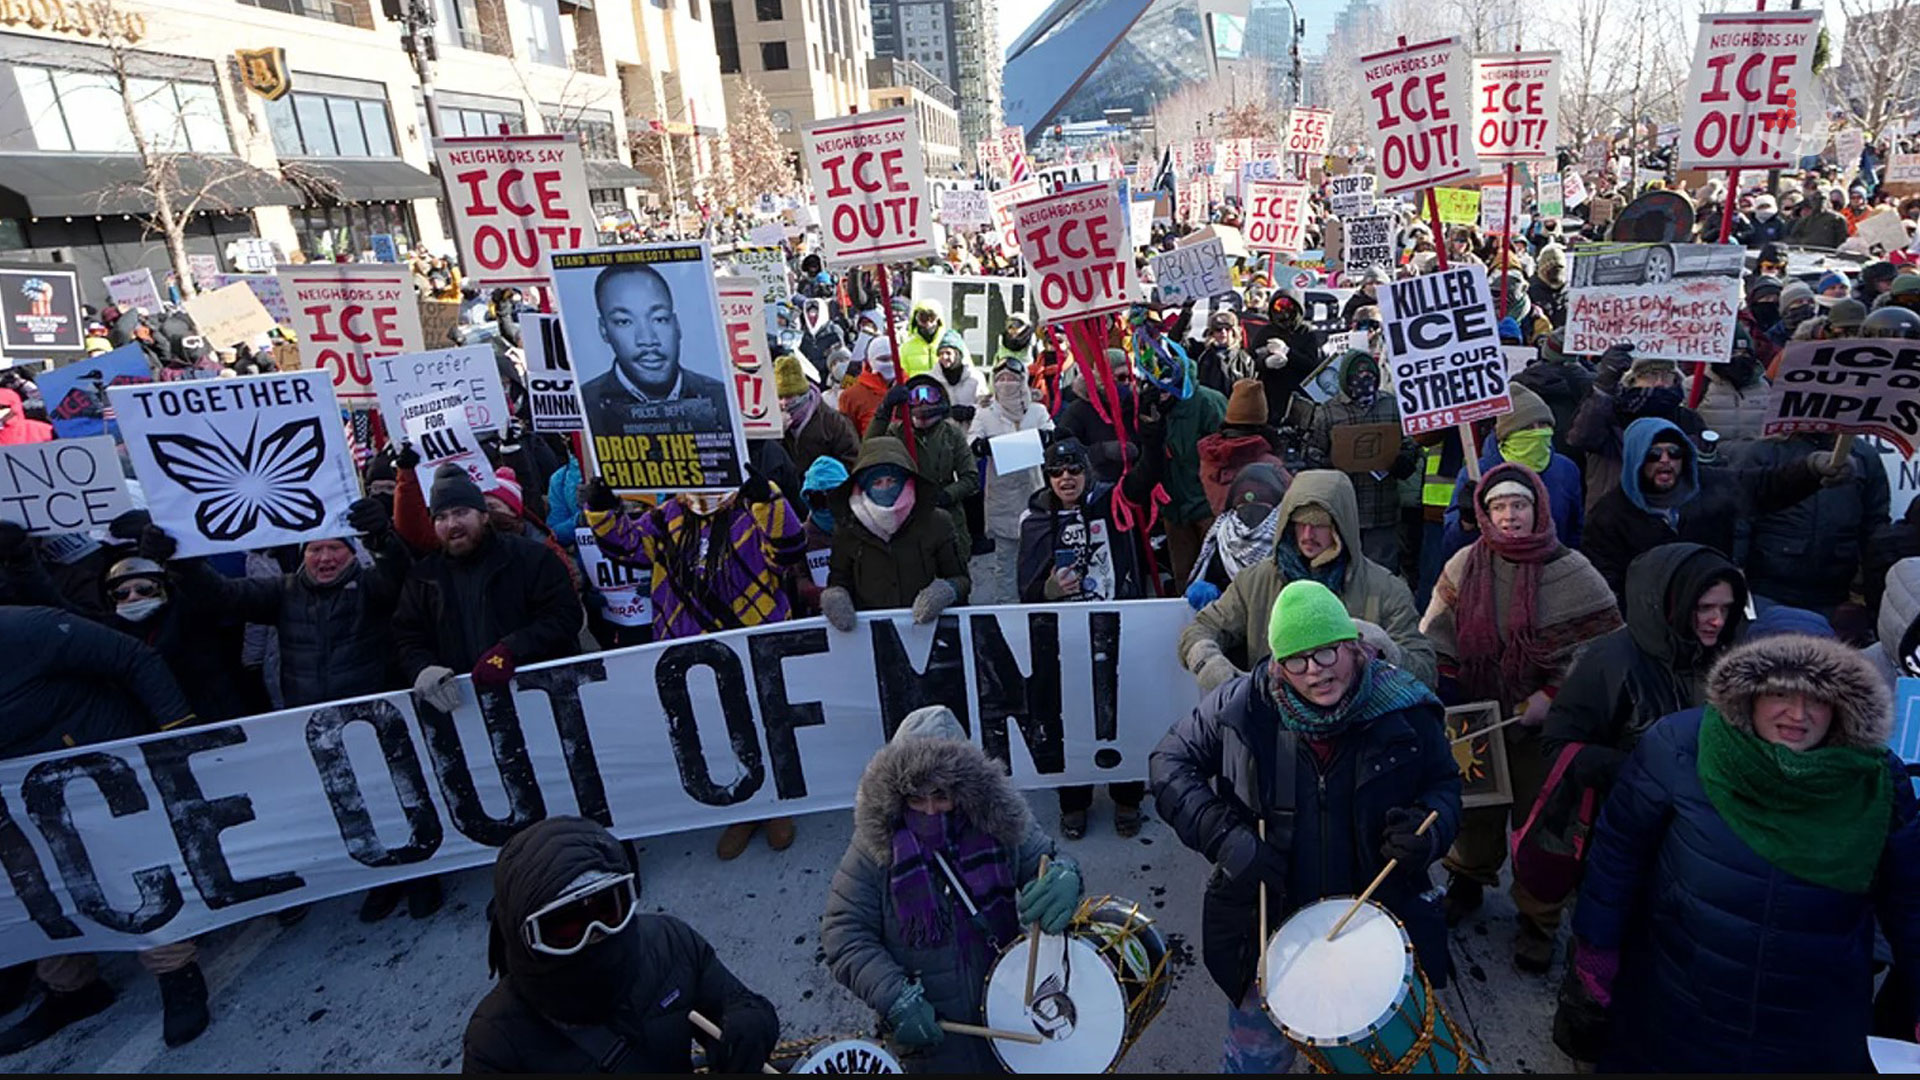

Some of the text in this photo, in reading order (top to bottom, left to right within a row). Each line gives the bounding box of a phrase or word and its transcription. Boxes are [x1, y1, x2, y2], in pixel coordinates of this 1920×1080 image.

[1710, 32, 1807, 49] NEIGHBORS SAY
[1365, 52, 1450, 82] NEIGHBORS SAY
[1701, 52, 1797, 105] ICE
[1371, 72, 1450, 130] ICE
[1482, 81, 1544, 115] ICE
[1292, 118, 1325, 136] ICE
[1479, 119, 1548, 150] OUT!
[1694, 110, 1791, 160] OUT!
[450, 149, 564, 165] NEIGHBORS SAY
[815, 131, 905, 154] NEIGHBORS SAY
[1290, 134, 1325, 151] OUT!
[1383, 124, 1460, 180] OUT!
[822, 149, 910, 198] ICE
[1333, 178, 1359, 194] STOP
[457, 168, 570, 219] ICE
[833, 197, 919, 243] OUT!
[1020, 198, 1109, 227] NEIGHBORS SAY
[1252, 197, 1298, 222] ICE
[1026, 215, 1116, 270] ICE
[1249, 221, 1299, 247] OUT!
[554, 254, 587, 267] STAND
[588, 253, 613, 266] WITH
[615, 250, 671, 264] MINNESOTA
[1157, 244, 1226, 283] ABOLISH
[1350, 246, 1391, 261] MURDER
[297, 288, 401, 301] NEIGHBORS SAY
[1040, 262, 1126, 310] OUT!
[1182, 272, 1219, 298] ICE
[1391, 270, 1478, 320] KILLER
[731, 303, 753, 316] SAY
[304, 305, 404, 347] ICE
[1388, 304, 1493, 356] ICE
[1626, 314, 1683, 335] SHEDS
[1688, 321, 1726, 337] OUR
[1636, 338, 1664, 354] ON
[1673, 335, 1725, 355] THEE
[1810, 346, 1920, 372] ICE
[316, 348, 398, 387] OU
[380, 353, 472, 384] I prefer
[1397, 346, 1498, 378] OFF OUR
[1398, 361, 1506, 415] STREETS
[1784, 369, 1882, 387] OUT
[57, 389, 91, 419] ICE
[132, 379, 314, 418] TOGETHER
[403, 394, 463, 420] LEGALIZATION
[532, 394, 581, 416] MINN
[1778, 390, 1920, 436] MPLS
[424, 413, 446, 430] FOR
[420, 427, 468, 460] ALL
[595, 435, 651, 463] DROP
[656, 433, 699, 461] THE
[4, 445, 97, 494] NO
[601, 460, 705, 487] CHARGES
[2, 487, 116, 532] ICE
[0, 610, 1124, 941] ICE OUT OF MN!
